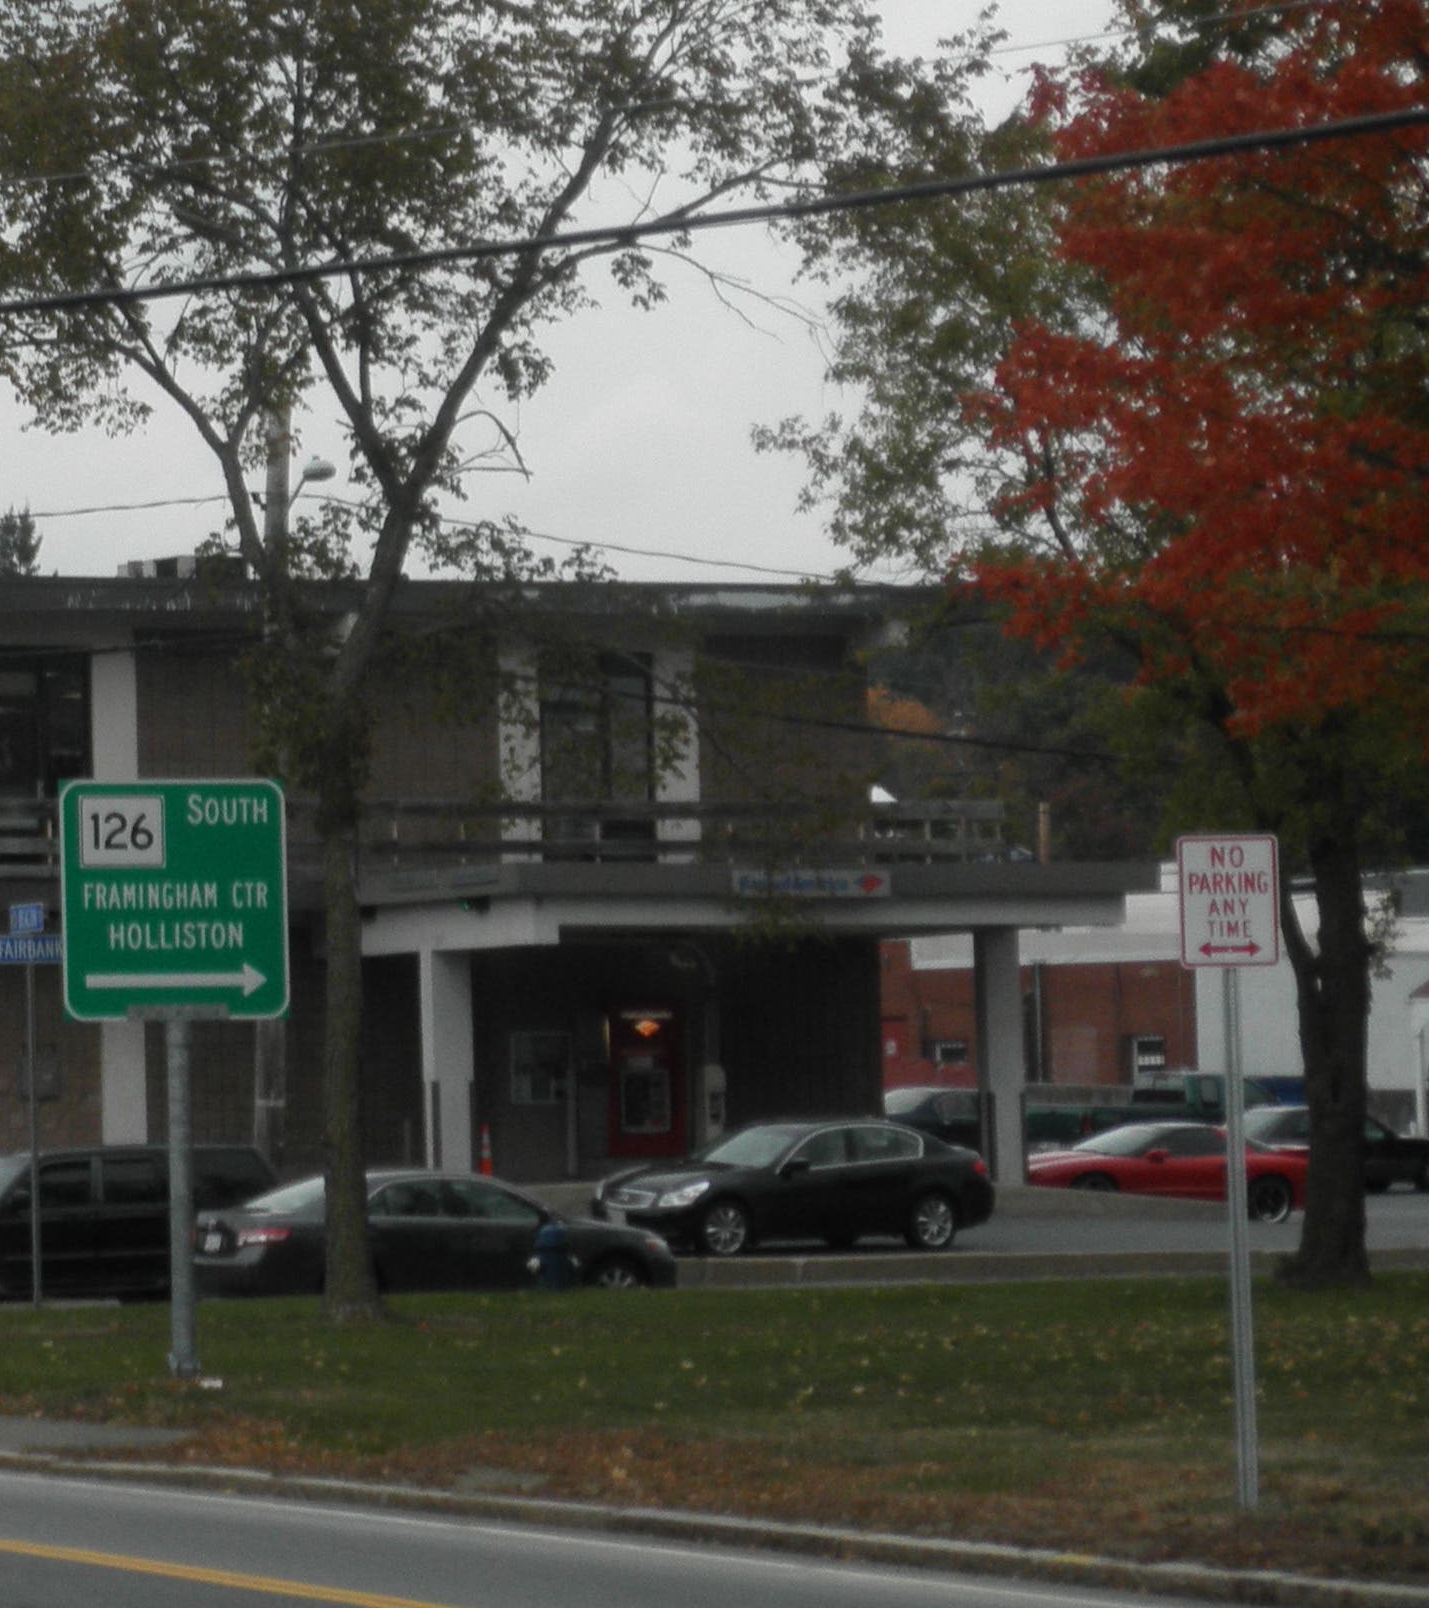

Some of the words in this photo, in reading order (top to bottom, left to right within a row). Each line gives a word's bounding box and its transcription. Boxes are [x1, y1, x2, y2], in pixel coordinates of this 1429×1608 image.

[91, 812, 154, 851] 126
[187, 794, 269, 825] SOUTH
[1209, 844, 1244, 868] NO
[83, 881, 218, 910] FRAMINGHAM
[232, 881, 269, 909] CTR
[1188, 872, 1268, 895] PARKING
[1208, 898, 1248, 916] ANY
[109, 922, 244, 950] HOLLISTON
[1206, 919, 1252, 938] TIME
